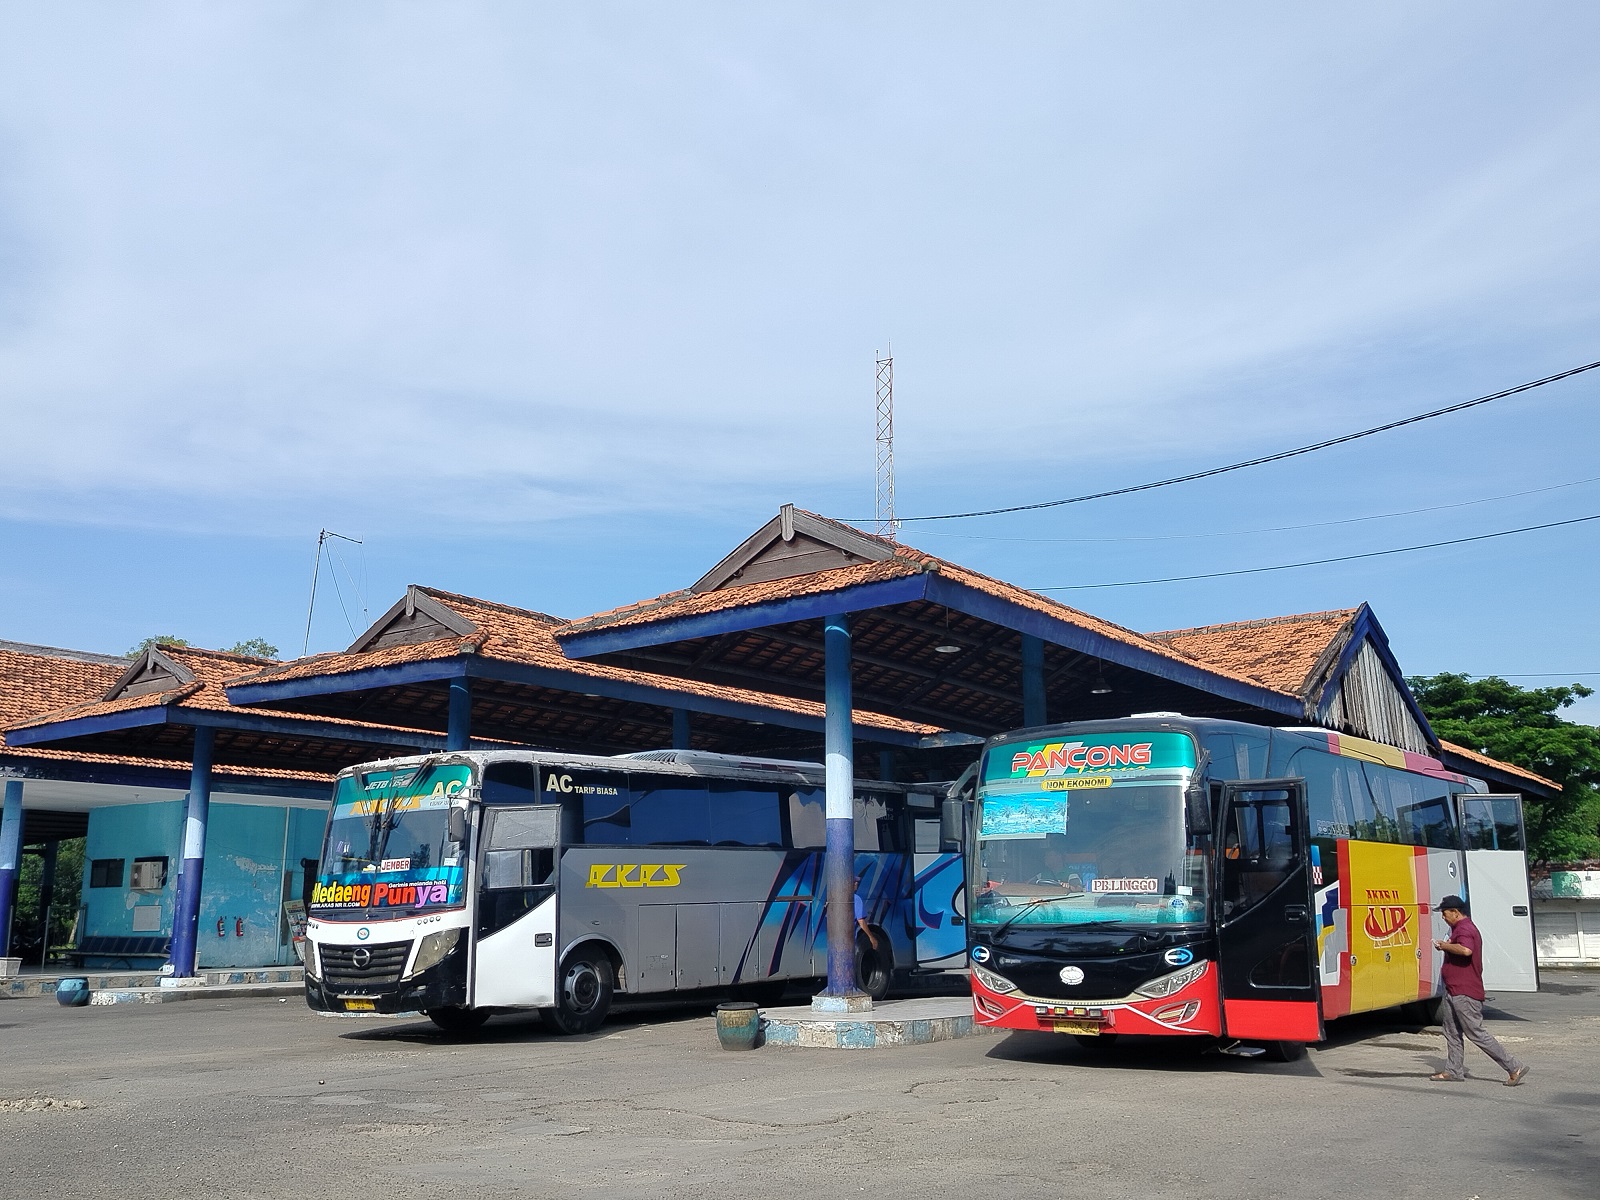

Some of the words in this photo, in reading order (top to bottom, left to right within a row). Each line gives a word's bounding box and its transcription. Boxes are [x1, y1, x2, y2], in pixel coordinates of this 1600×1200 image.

[1012, 742, 1152, 772] PANCONG
[430, 780, 463, 800] AC
[546, 773, 573, 793] AC
[574, 785, 596, 795] TARIP
[596, 786, 618, 796] BIASA
[1046, 780, 1065, 789] NON
[1067, 779, 1108, 789] EKONOMI
[381, 859, 410, 871] JEMBER
[585, 864, 688, 889] AKAS
[1093, 880, 1157, 891] PB.LINGGO
[311, 880, 371, 908] Medaeng
[373, 882, 448, 909] Punya
